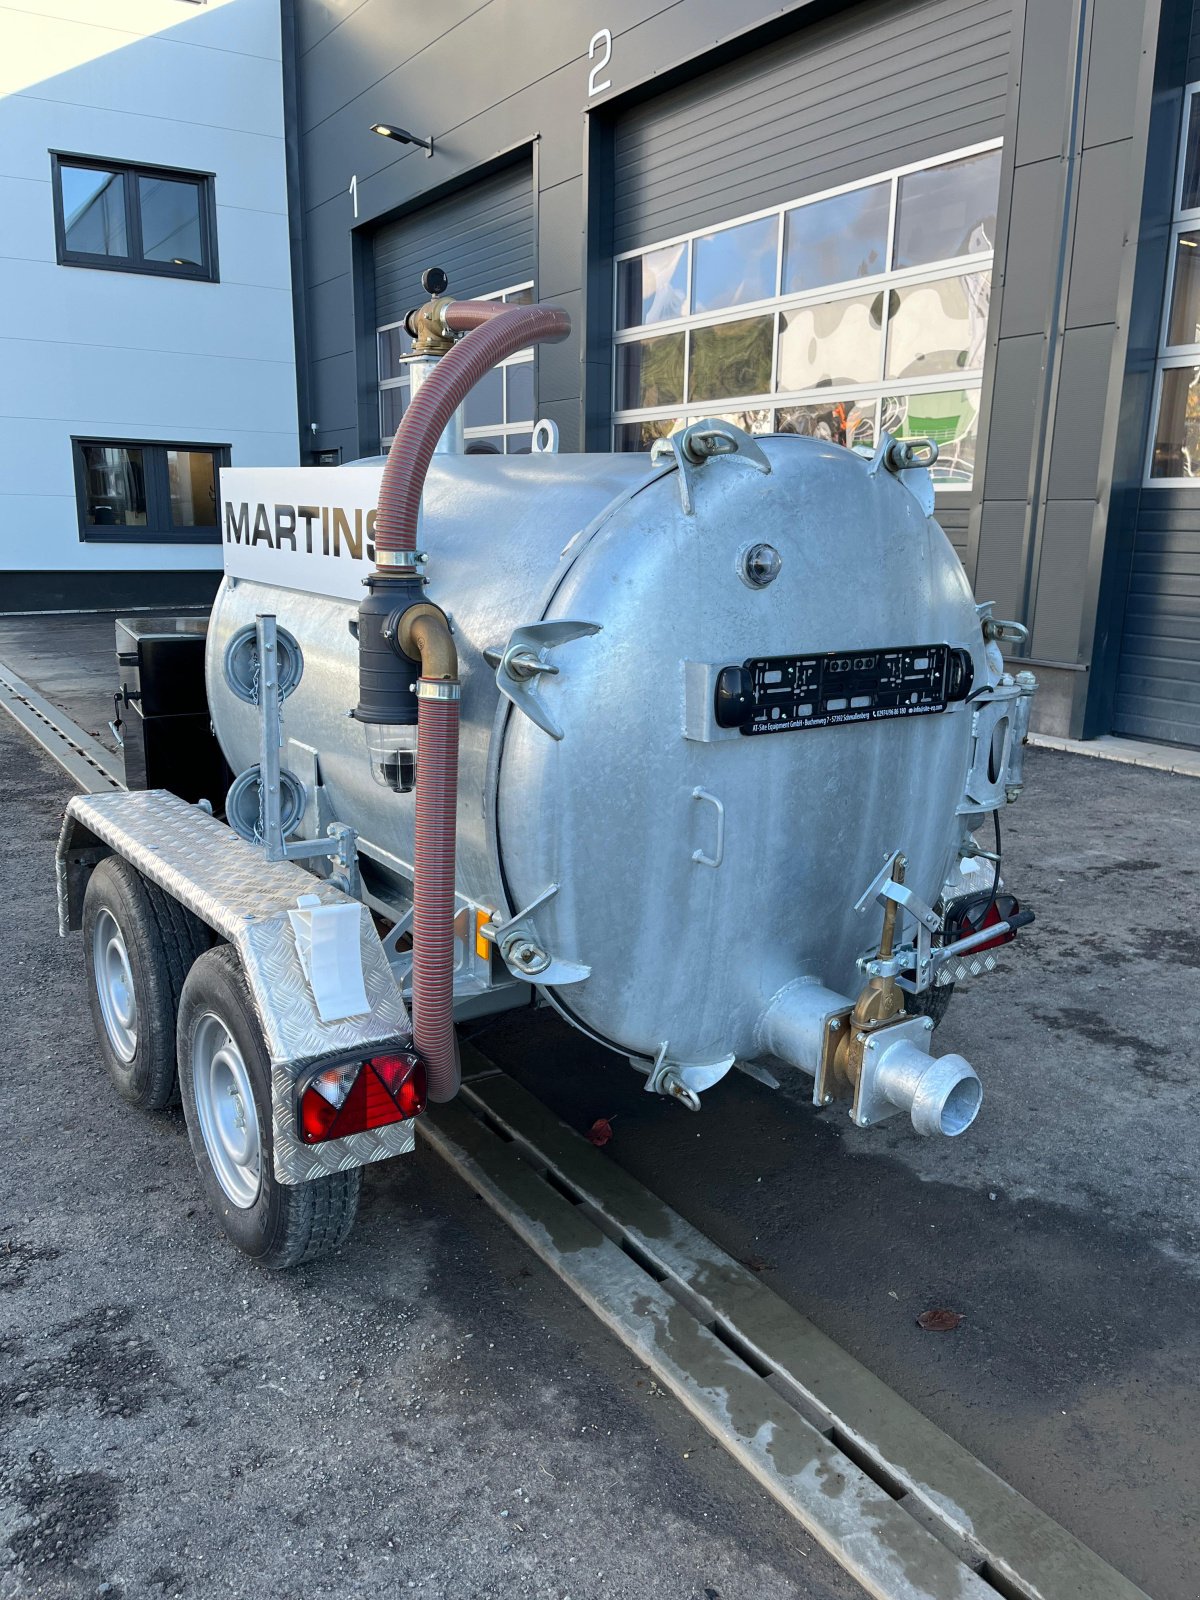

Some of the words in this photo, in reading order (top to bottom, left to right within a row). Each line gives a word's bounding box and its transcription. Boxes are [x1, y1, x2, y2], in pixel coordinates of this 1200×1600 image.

[589, 28, 612, 97] 2
[349, 174, 358, 218] 1
[768, 722, 789, 731] Equipment
[790, 719, 802, 727] GmbH
